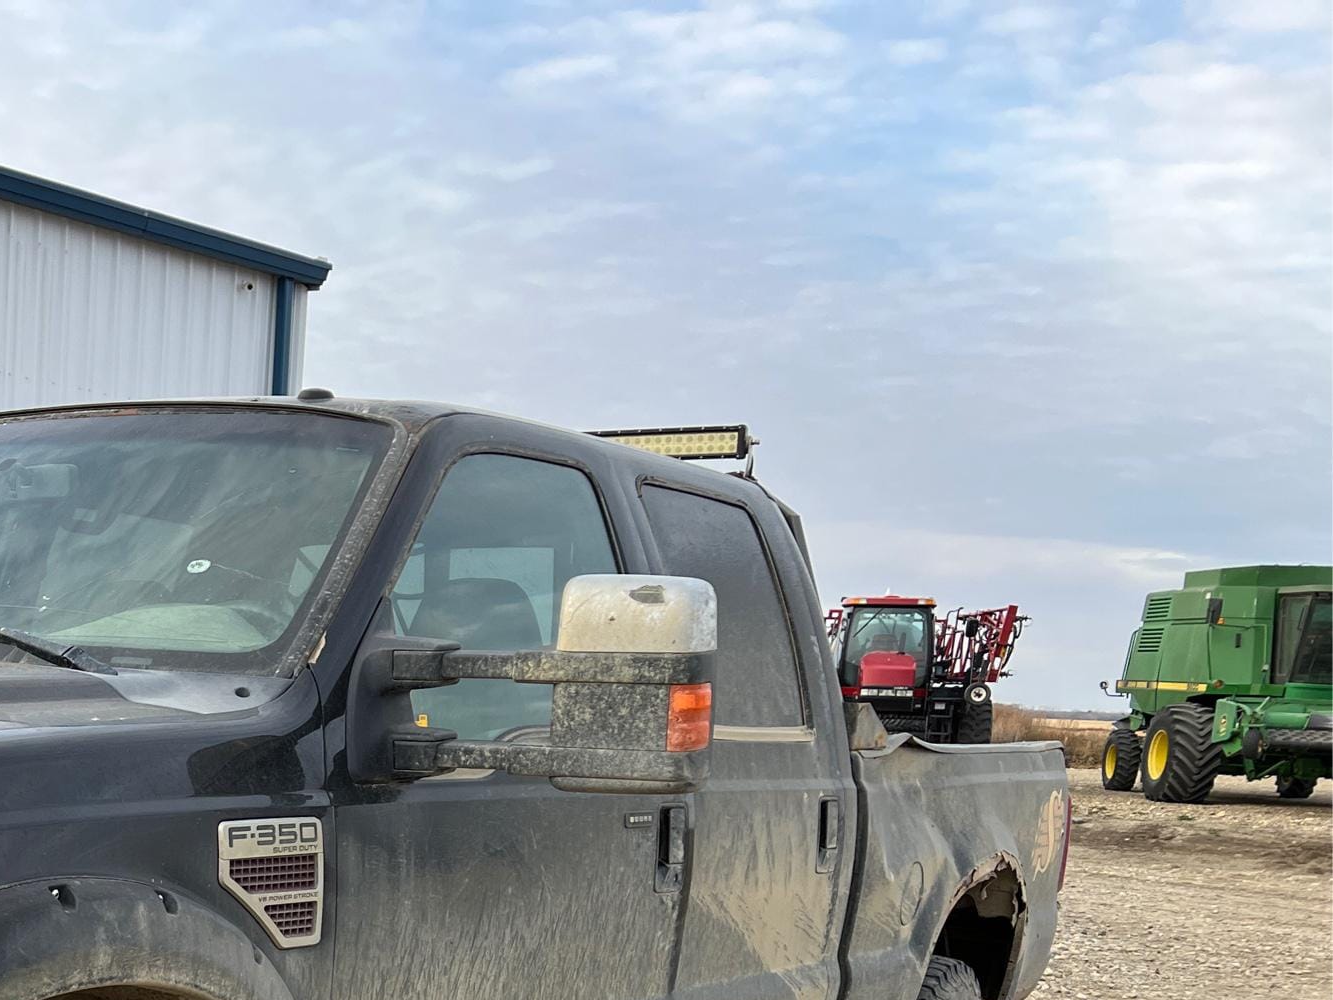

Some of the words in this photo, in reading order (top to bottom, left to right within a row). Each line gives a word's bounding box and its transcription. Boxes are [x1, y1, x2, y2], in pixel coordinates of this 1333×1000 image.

[272, 845, 298, 854] SUPER
[299, 844, 319, 852] DUTY
[268, 894, 293, 902] POWER
[293, 891, 319, 900] STROKE
